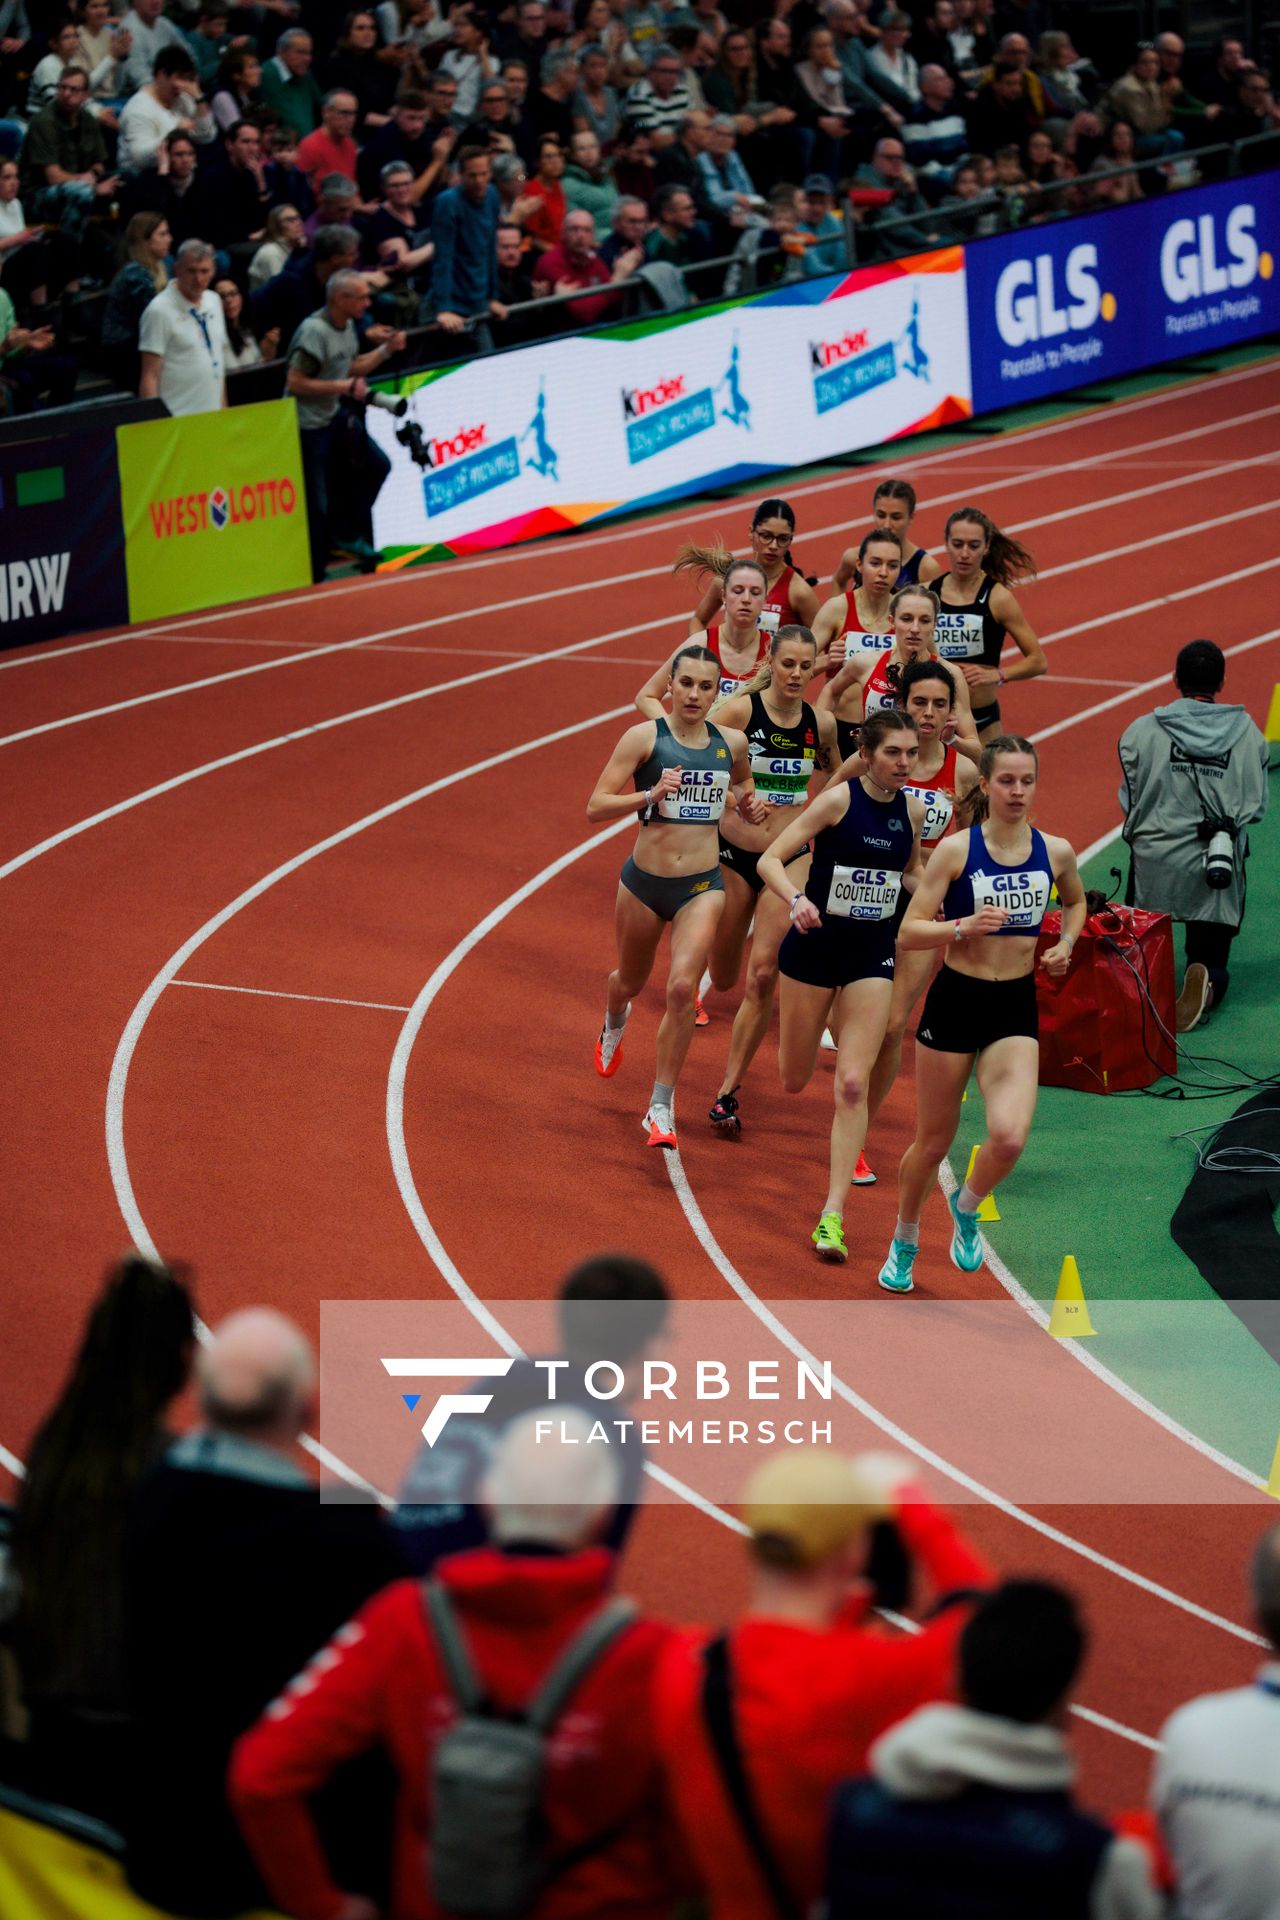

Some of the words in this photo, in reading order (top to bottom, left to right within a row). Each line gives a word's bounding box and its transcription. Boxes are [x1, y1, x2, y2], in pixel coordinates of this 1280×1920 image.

[863, 835, 892, 848] VIACTIV
[834, 882, 897, 905] COUTELLIER
[862, 907, 881, 916] PLAN
